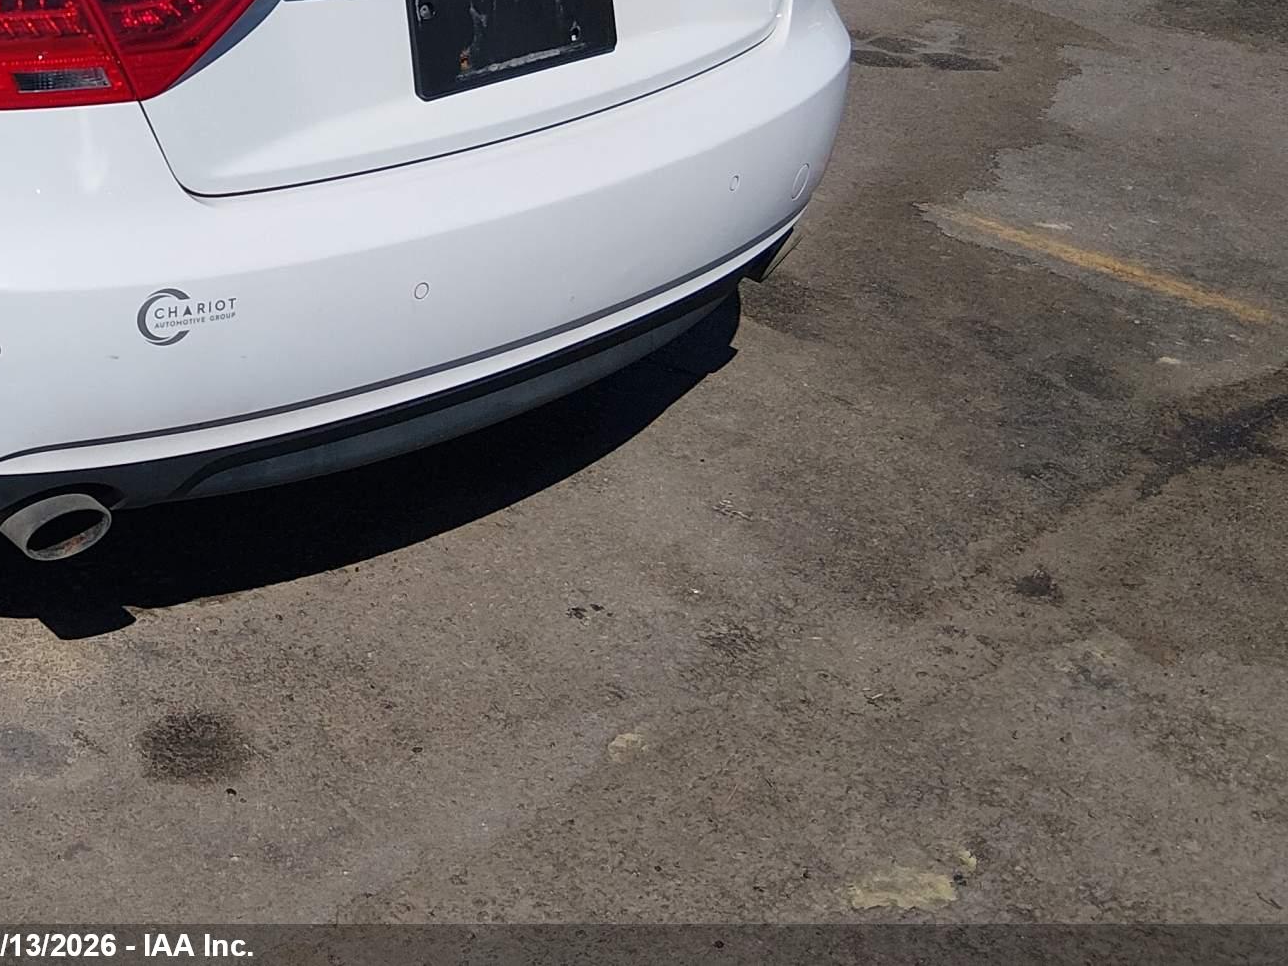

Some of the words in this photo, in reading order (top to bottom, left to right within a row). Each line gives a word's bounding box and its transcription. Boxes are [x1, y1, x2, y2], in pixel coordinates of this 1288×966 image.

[154, 297, 237, 319] CHARIOT
[154, 317, 206, 329] AUTOMOTIVE
[209, 312, 236, 322] GROUP
